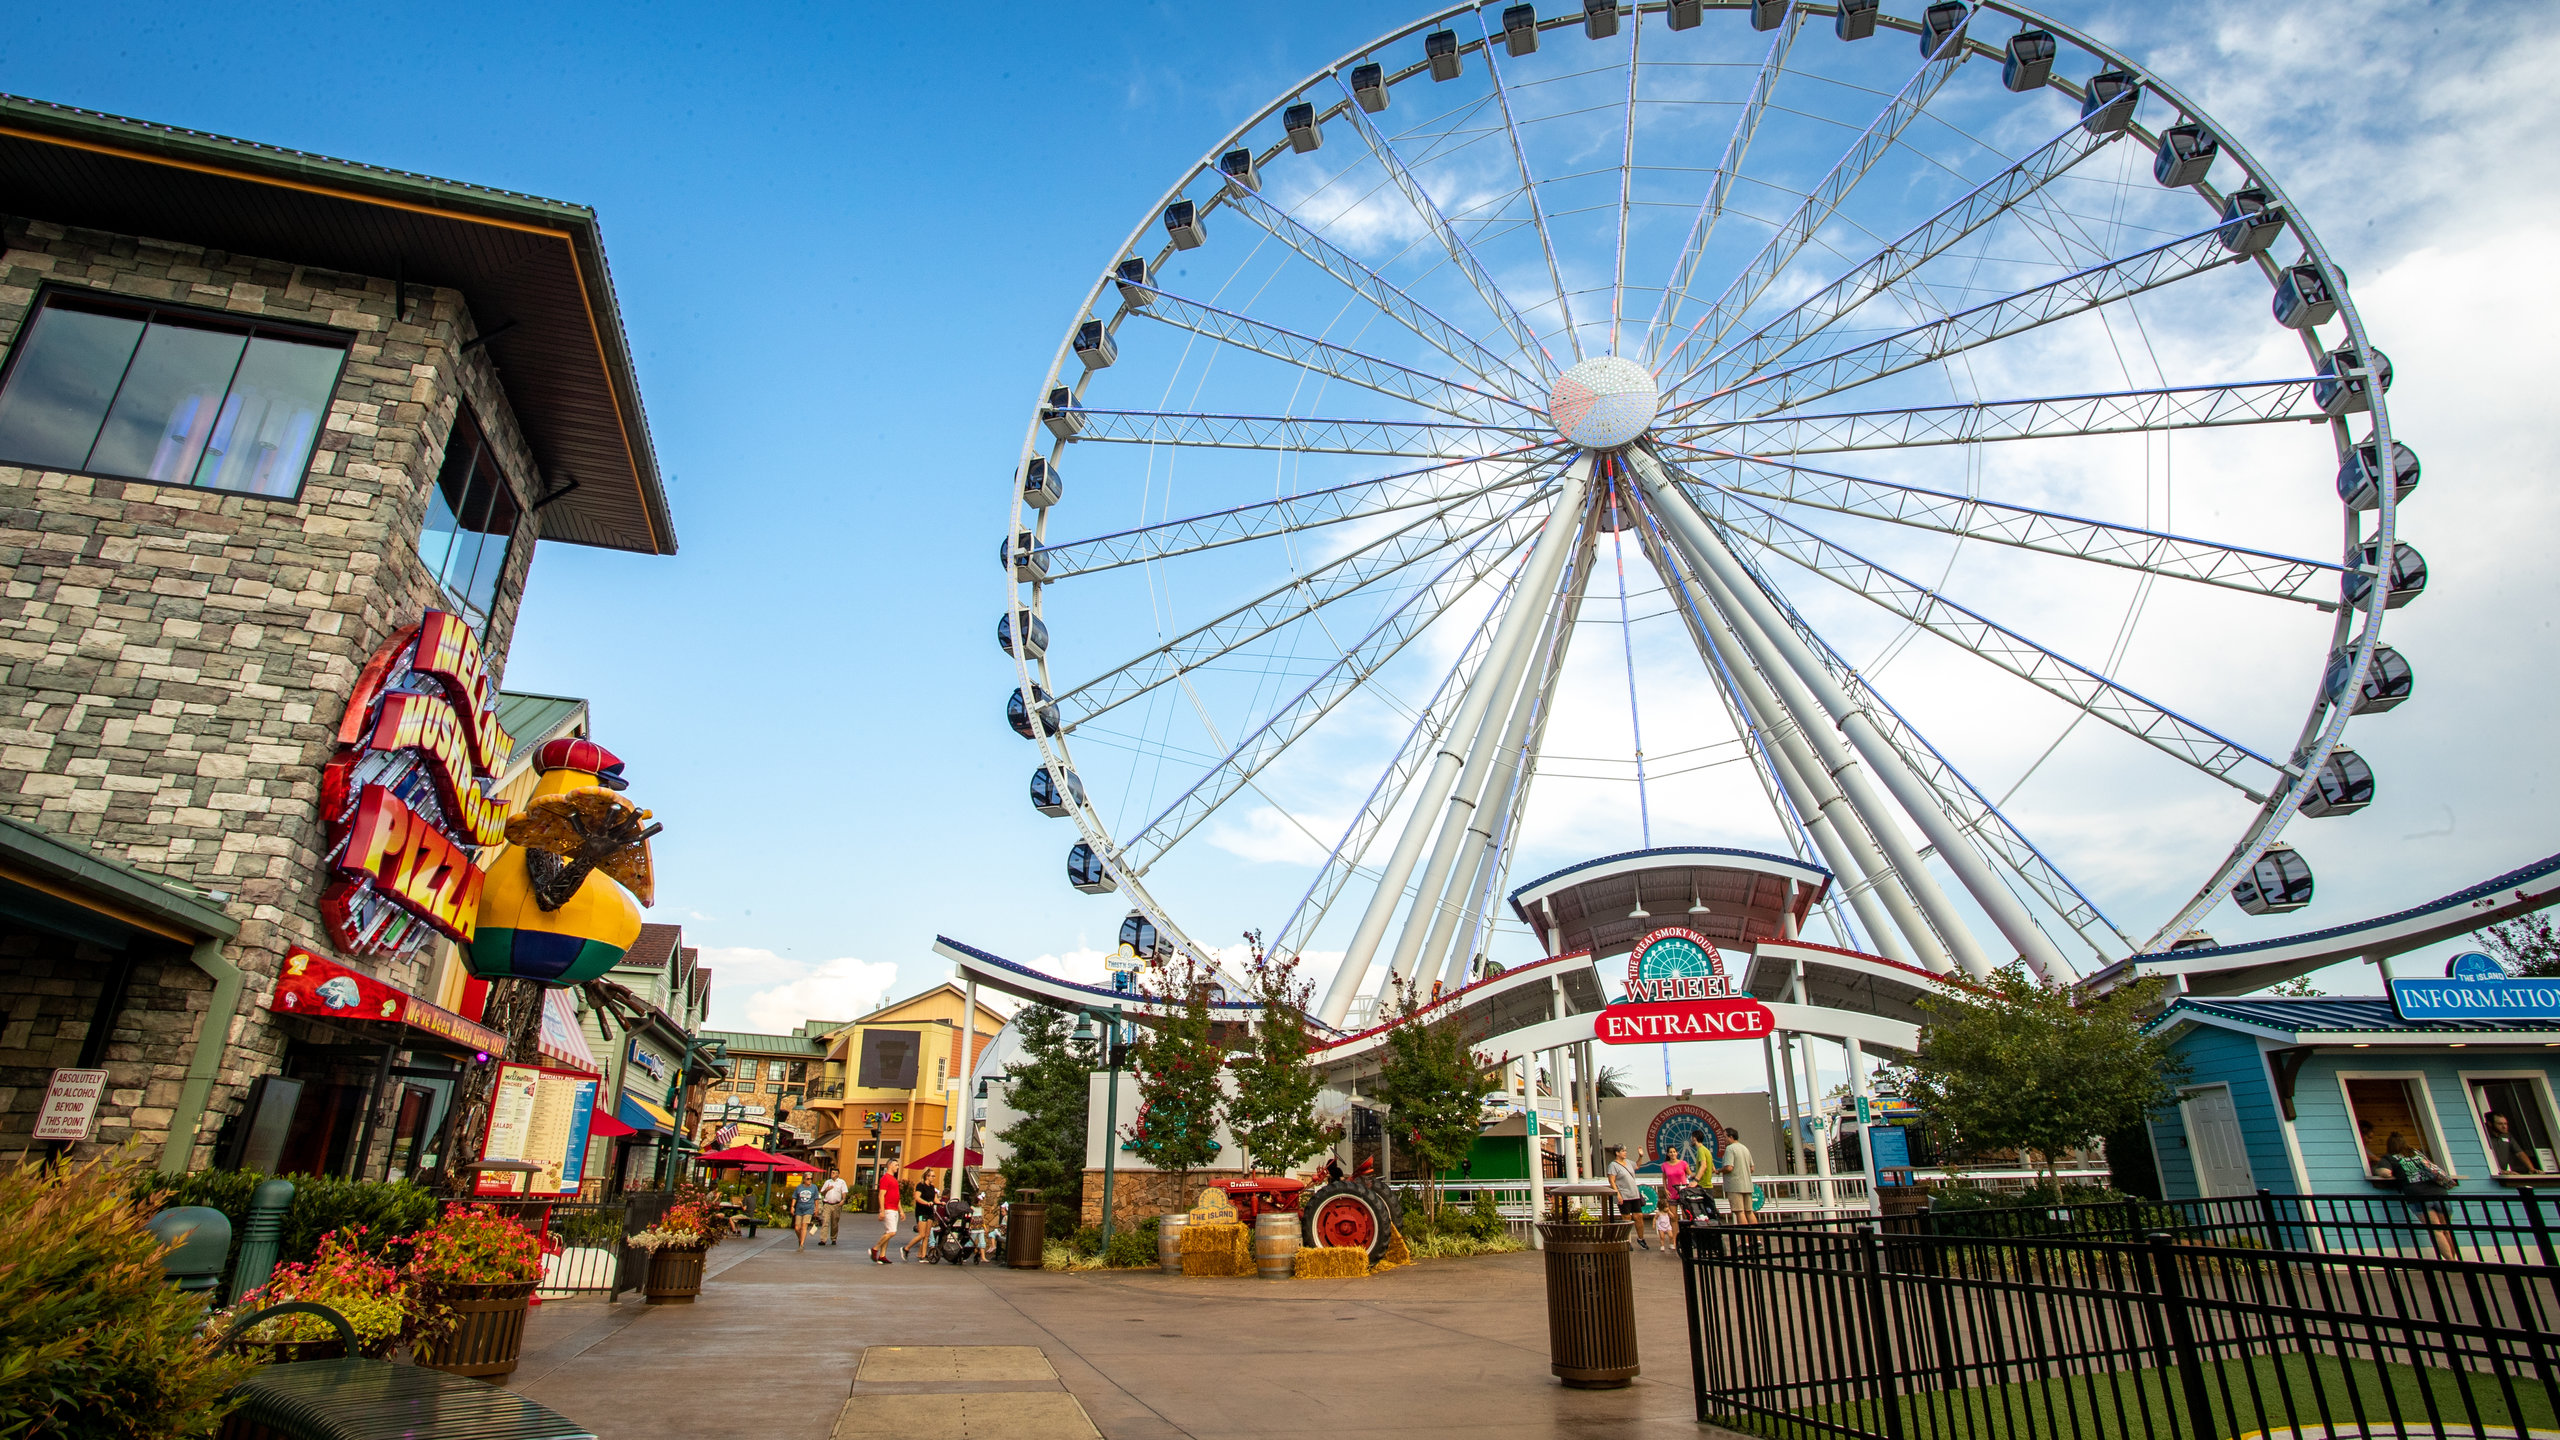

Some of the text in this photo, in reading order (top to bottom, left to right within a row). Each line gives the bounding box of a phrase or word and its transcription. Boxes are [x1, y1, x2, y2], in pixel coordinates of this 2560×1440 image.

[432, 613, 515, 779] MELLOW
[391, 695, 511, 846] MUSHROOM
[363, 785, 485, 943] PIZZA
[1630, 927, 1723, 978] THE GREAT SMOKY MOUNTAIN
[2458, 972, 2505, 982] THE ISLAND
[1620, 974, 1743, 1003] WHEEL
[430, 1012, 450, 1034] Been
[451, 1020, 474, 1042] Baked
[472, 1029, 490, 1050] Since
[1606, 1011, 1763, 1037] ENTRANCE
[58, 1073, 102, 1084] ABSOLUTELY
[51, 1088, 96, 1098] NO ALCOHOL
[54, 1102, 84, 1112] BEYOND
[1660, 1106, 1682, 1120] SMOKY
[45, 1116, 85, 1126] THIS POINT
[1648, 1118, 1662, 1139] GREAT
[1684, 1106, 1718, 1130] MOUNTAIN
[1648, 1140, 1656, 1154] THE
[1208, 1211, 1234, 1219] ISLAND
